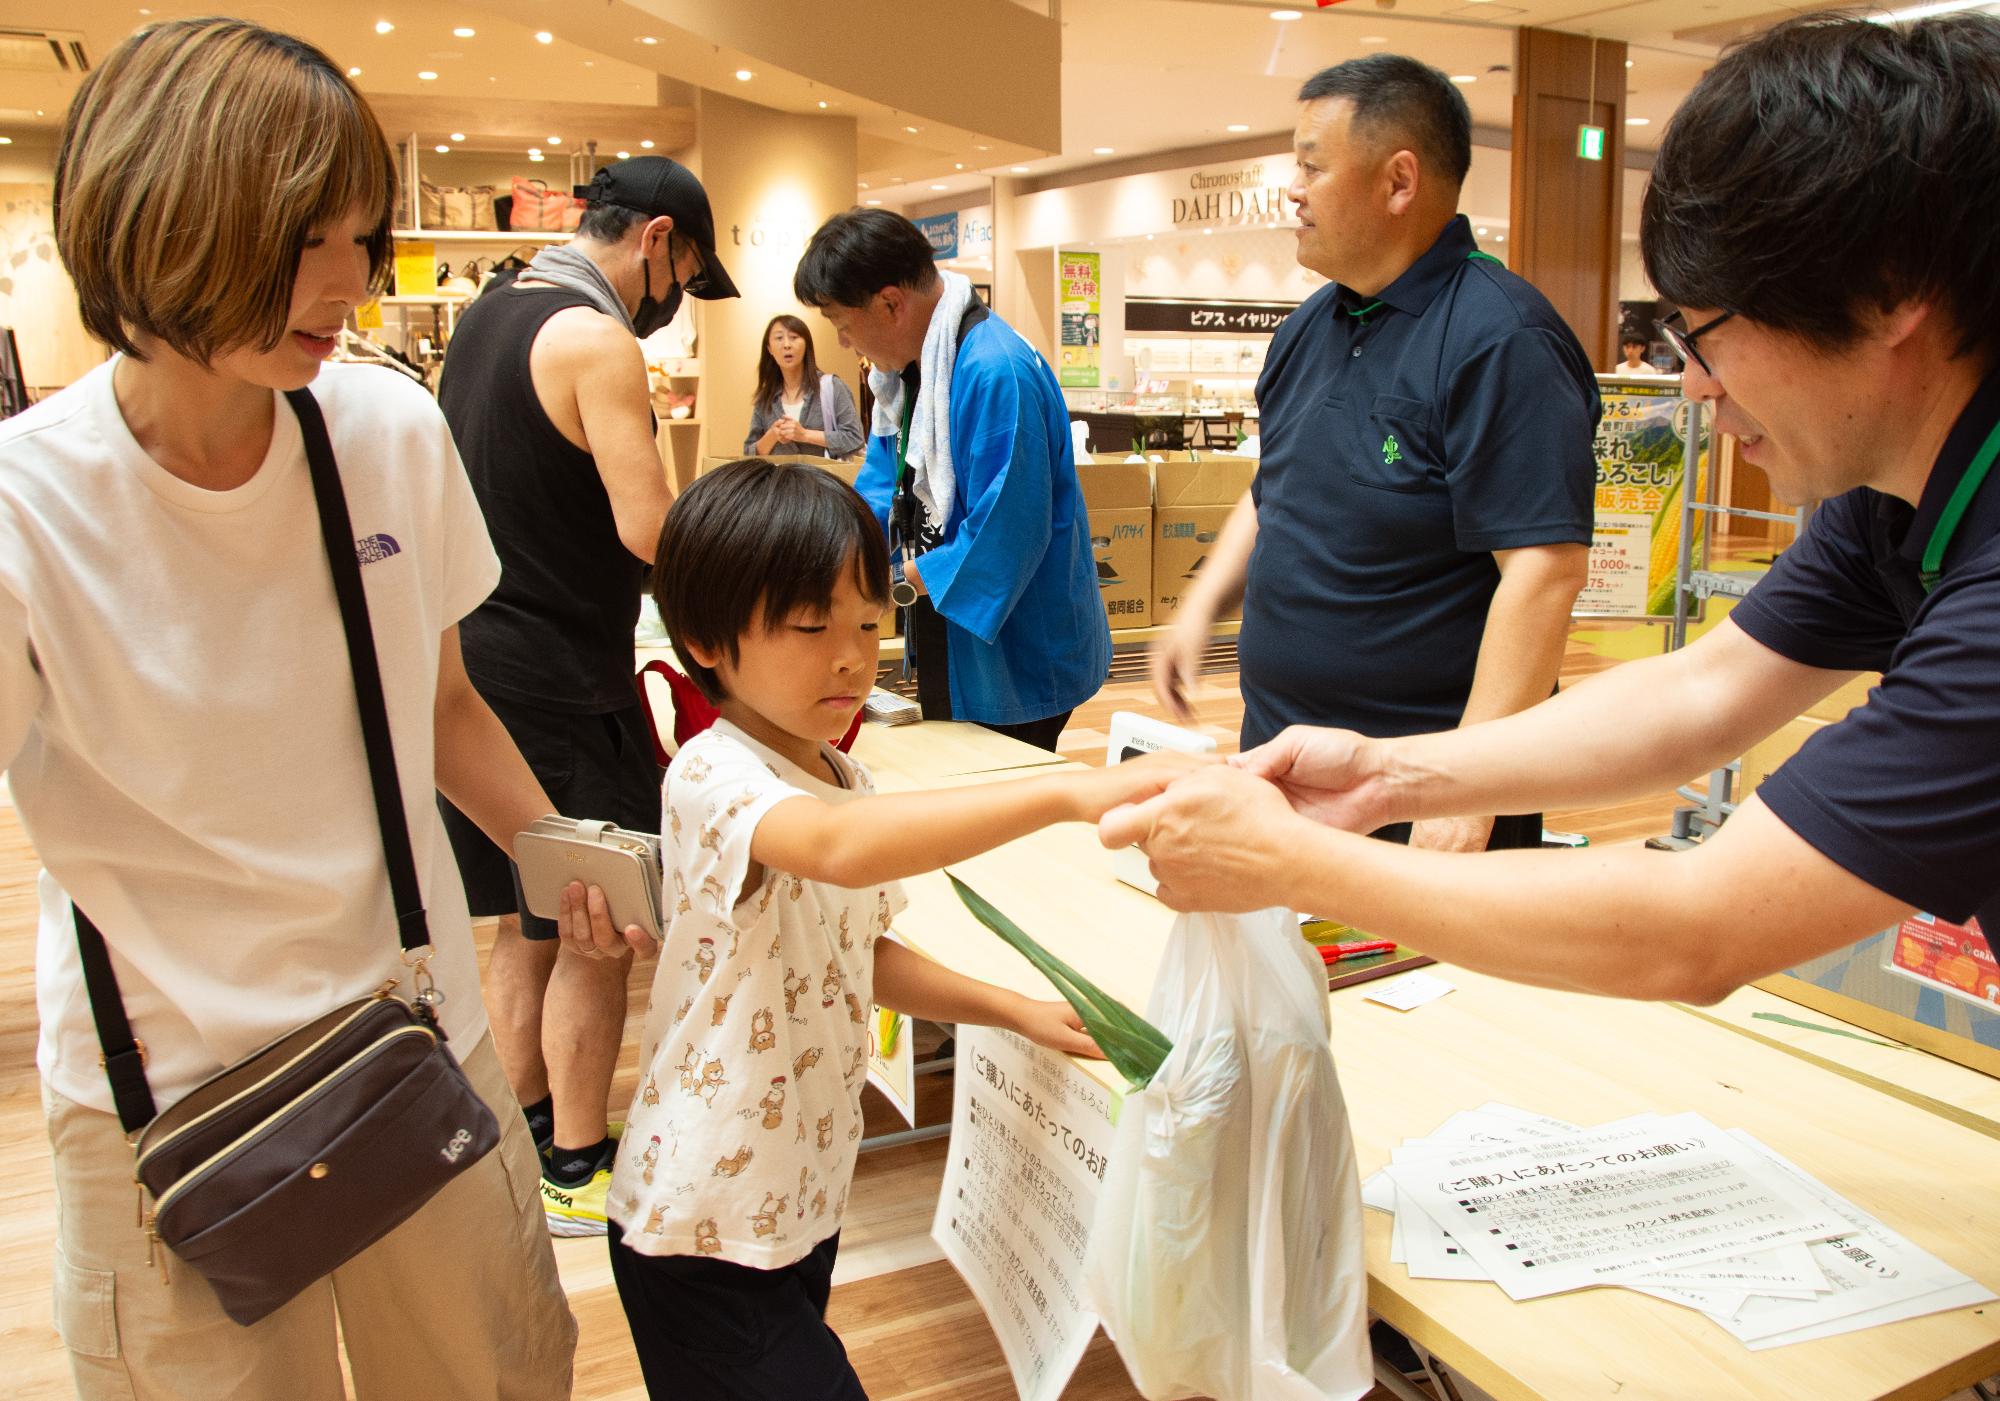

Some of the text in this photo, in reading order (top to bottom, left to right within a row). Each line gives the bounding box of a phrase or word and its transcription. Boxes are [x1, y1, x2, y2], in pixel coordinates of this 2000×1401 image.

[1190, 164, 1263, 190] Chronostaff
[1172, 188, 1286, 224] DAH DAH
[1063, 264, 1092, 279] 無料
[1070, 282, 1097, 296] 点検
[1190, 310, 1288, 328] ピアス・イヤリン
[1112, 523, 1145, 539] ハクサイ
[357, 535, 378, 549] THE
[1108, 598, 1145, 616] 協同組合
[440, 1129, 473, 1164] Lee
[1438, 1137, 1705, 1194] 《ご購入にあたってのお願い》
[540, 1182, 574, 1208] HOKA
